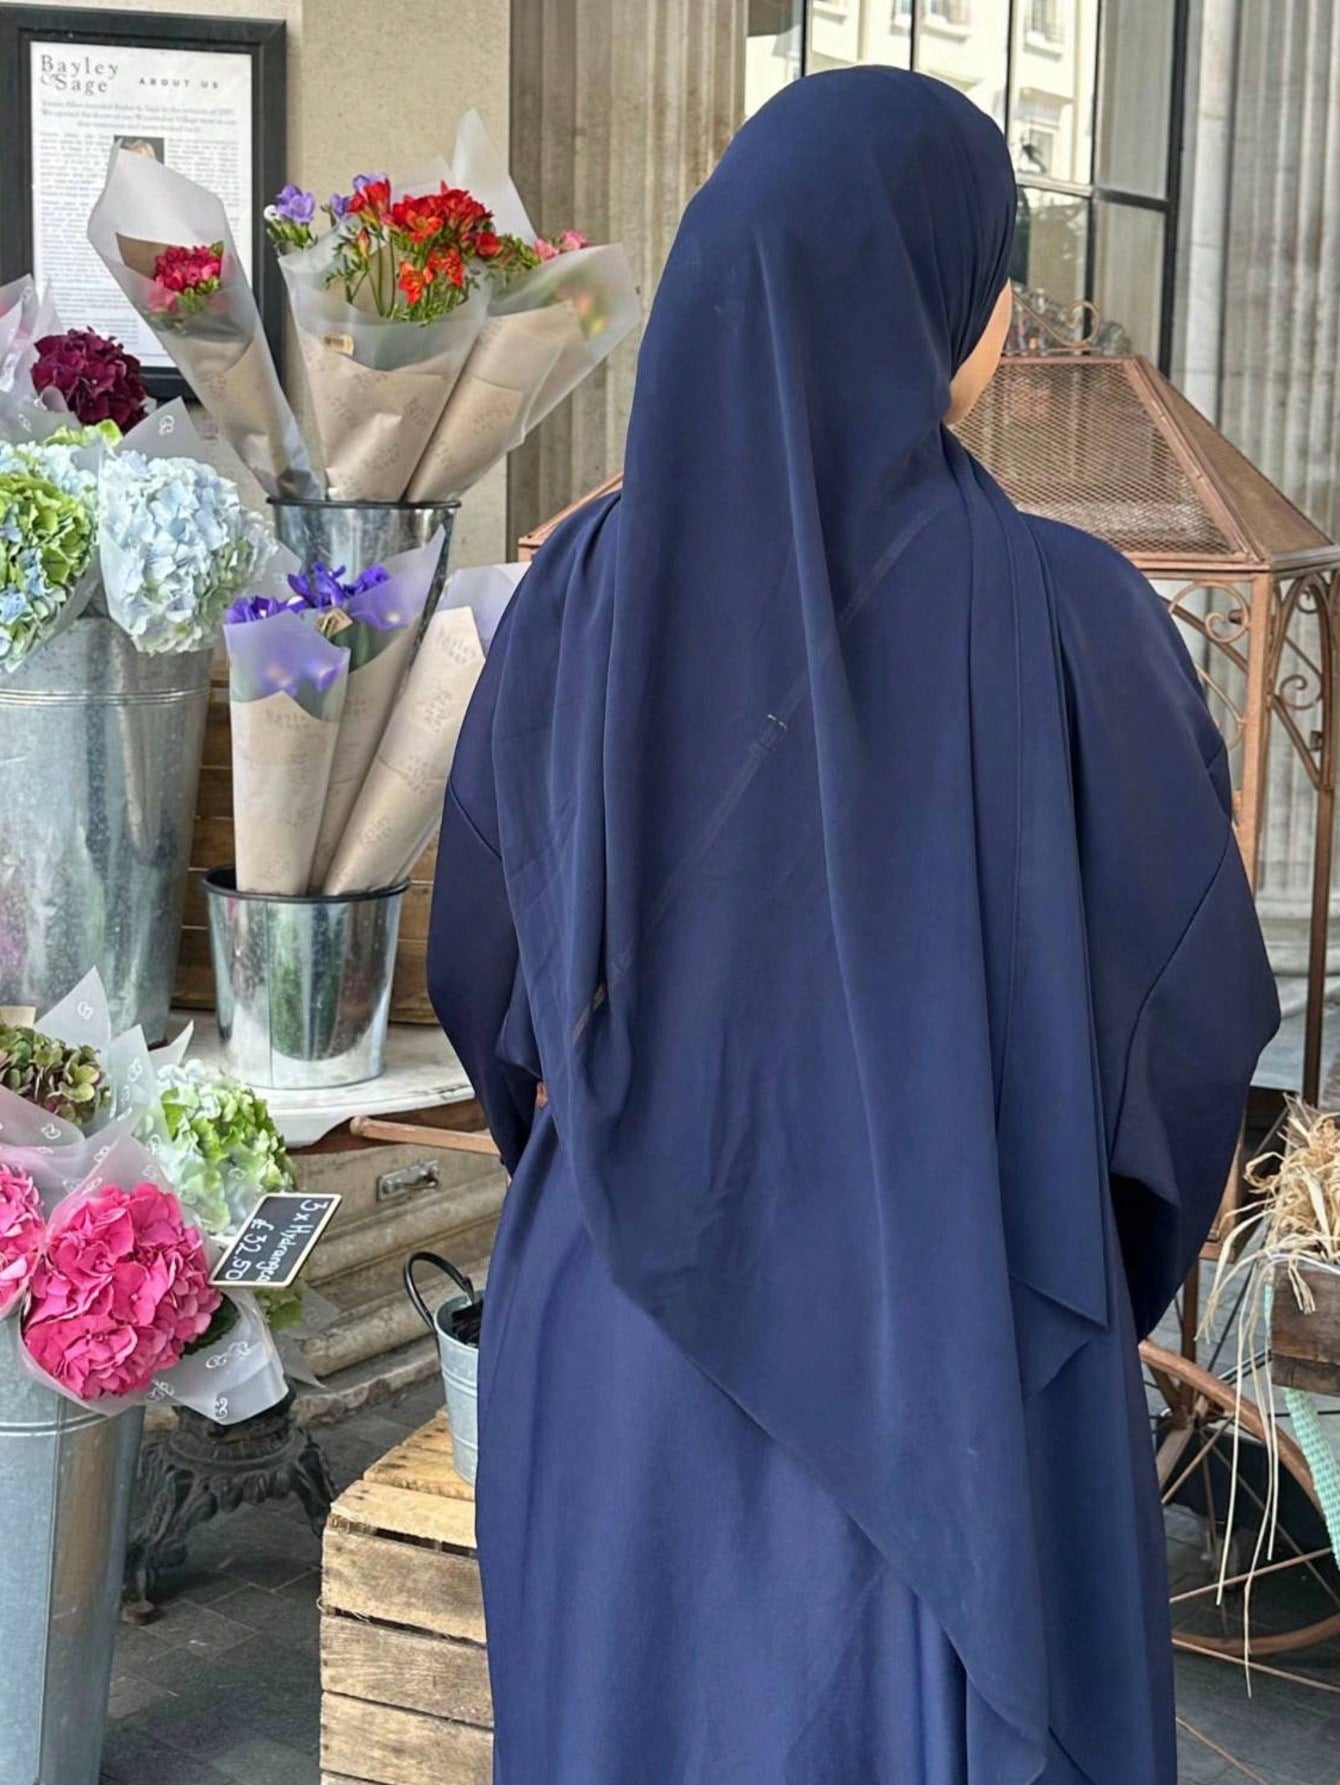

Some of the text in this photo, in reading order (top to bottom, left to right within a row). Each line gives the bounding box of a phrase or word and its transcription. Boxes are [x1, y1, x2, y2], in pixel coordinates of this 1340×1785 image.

[41, 55, 118, 78] Bayley
[300, 1199, 329, 1211] 3
[256, 1224, 315, 1282] Hydrangea
